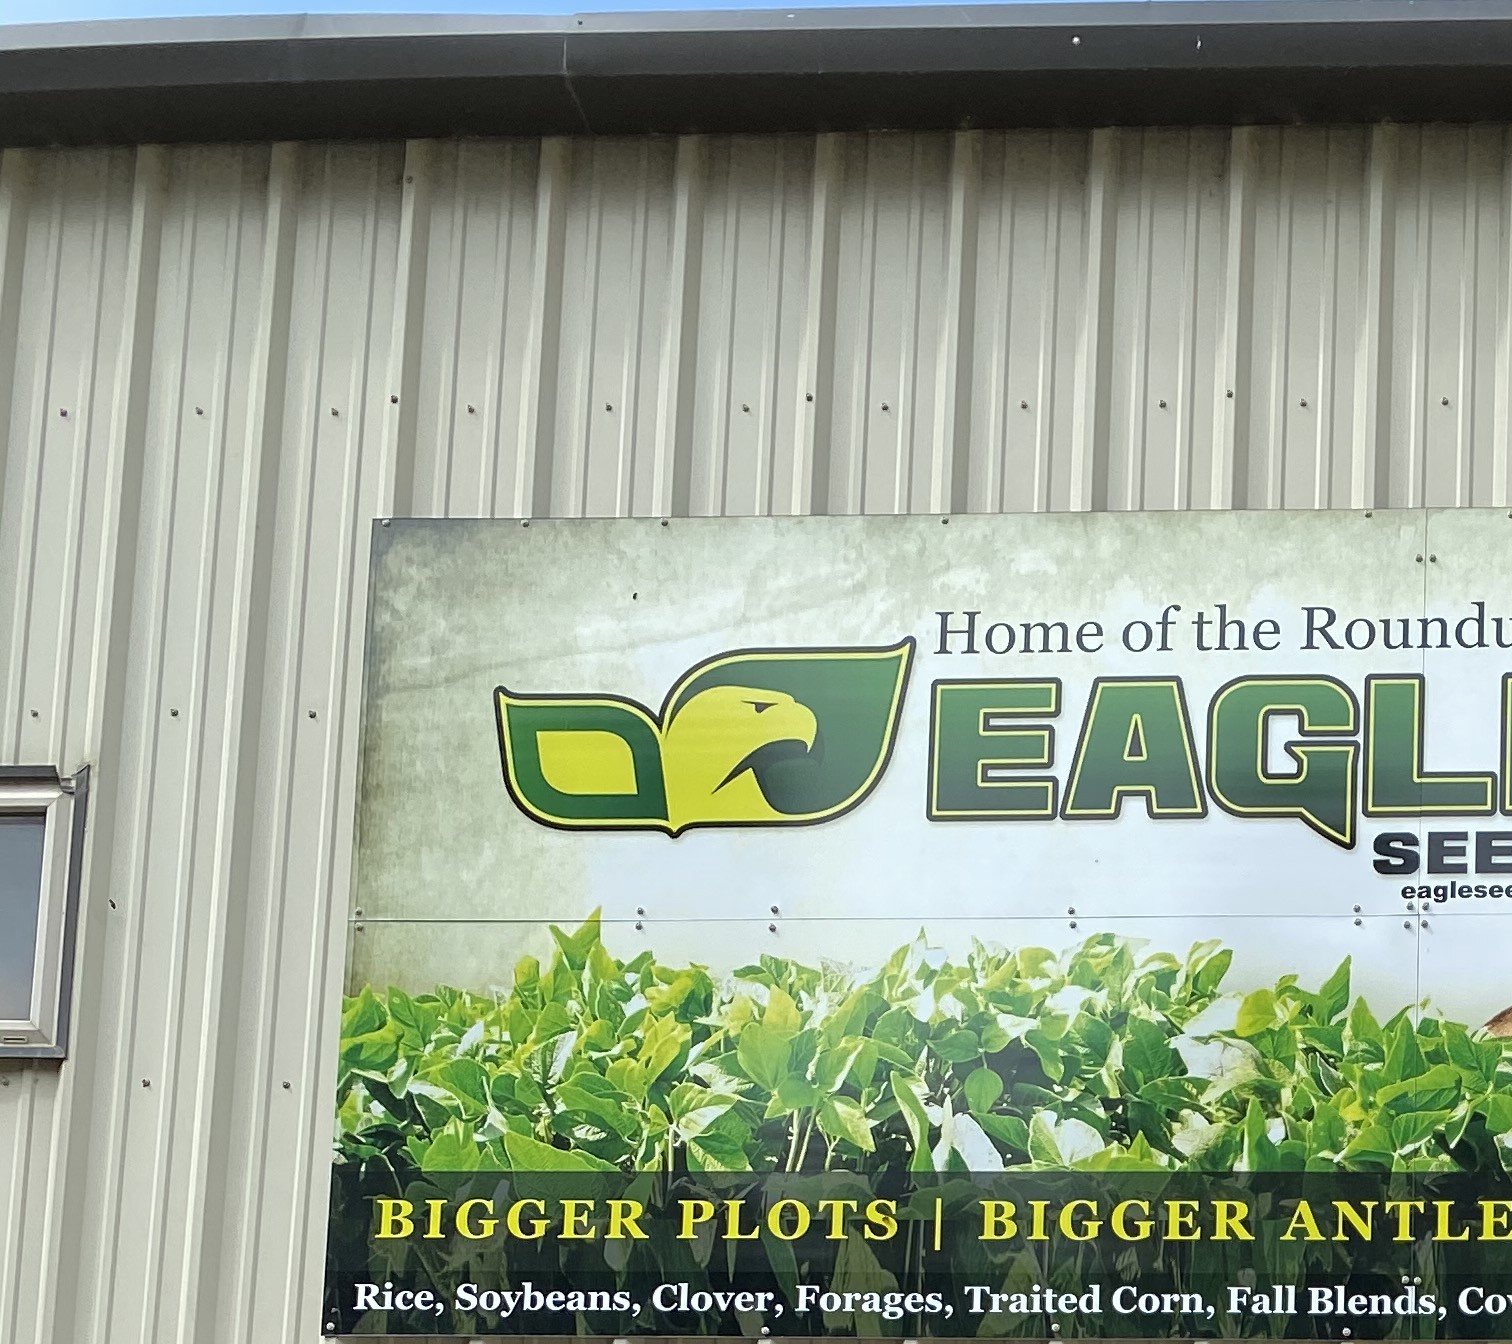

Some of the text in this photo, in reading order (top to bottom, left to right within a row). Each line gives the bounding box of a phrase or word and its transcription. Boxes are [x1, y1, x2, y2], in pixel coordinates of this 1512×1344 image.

[934, 609, 1103, 655] Home
[1122, 605, 1182, 653] of
[1191, 603, 1281, 651] the
[374, 1198, 650, 1241] BIGGER
[676, 1198, 900, 1241] PLOTS
[977, 1199, 1256, 1241] BIGGER
[352, 1282, 445, 1317] Rice,
[455, 1282, 641, 1318] Soybeans,
[652, 1283, 784, 1318] Clover,
[794, 1285, 954, 1320] Forages,
[964, 1285, 1103, 1315] Traited
[1112, 1286, 1215, 1320] Corn,
[1226, 1285, 1297, 1314] Fall
[1307, 1285, 1447, 1321] Blends,
